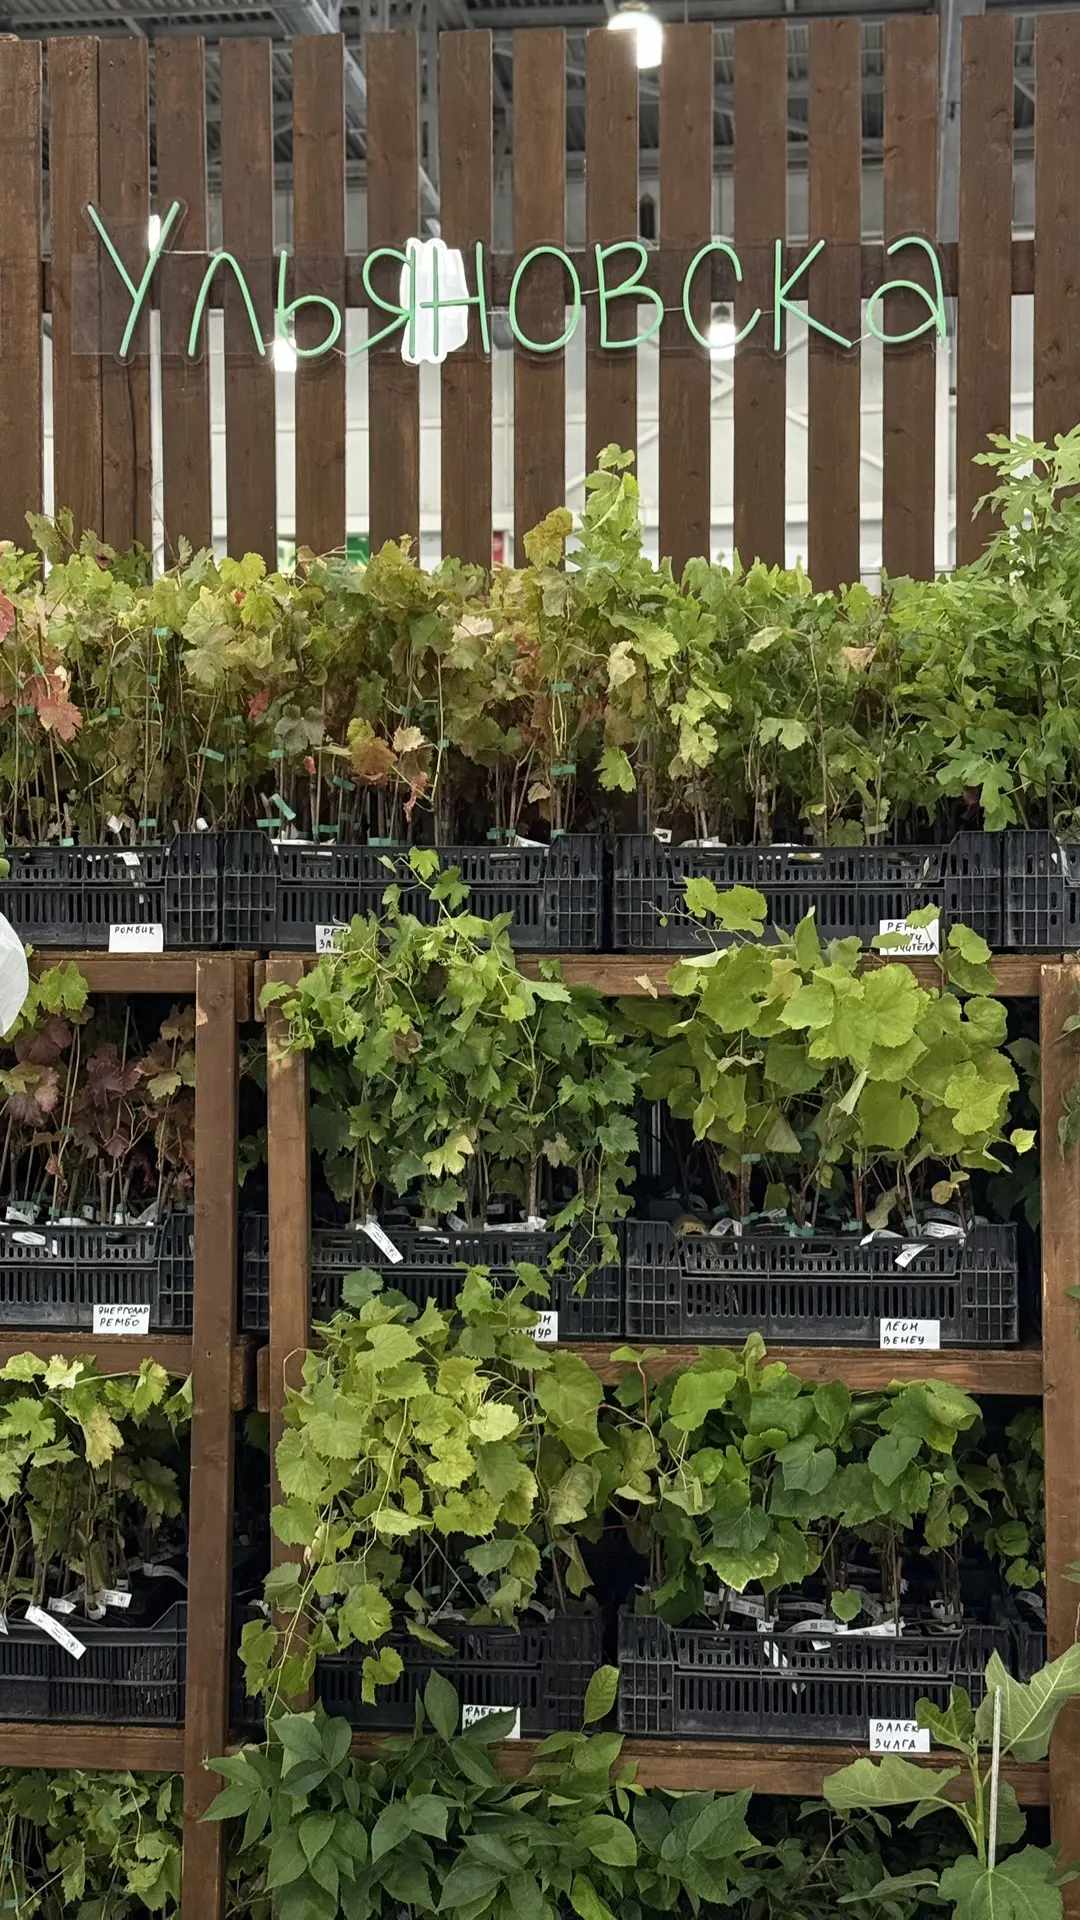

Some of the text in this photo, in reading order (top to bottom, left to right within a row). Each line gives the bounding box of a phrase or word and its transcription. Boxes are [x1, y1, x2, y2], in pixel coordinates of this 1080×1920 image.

[114, 925, 155, 936] РОМБИК
[99, 1317, 140, 1327] РЕМБО
[884, 1321, 919, 1332] ЛЕОН
[874, 1738, 916, 1750] ЗИЛГА
